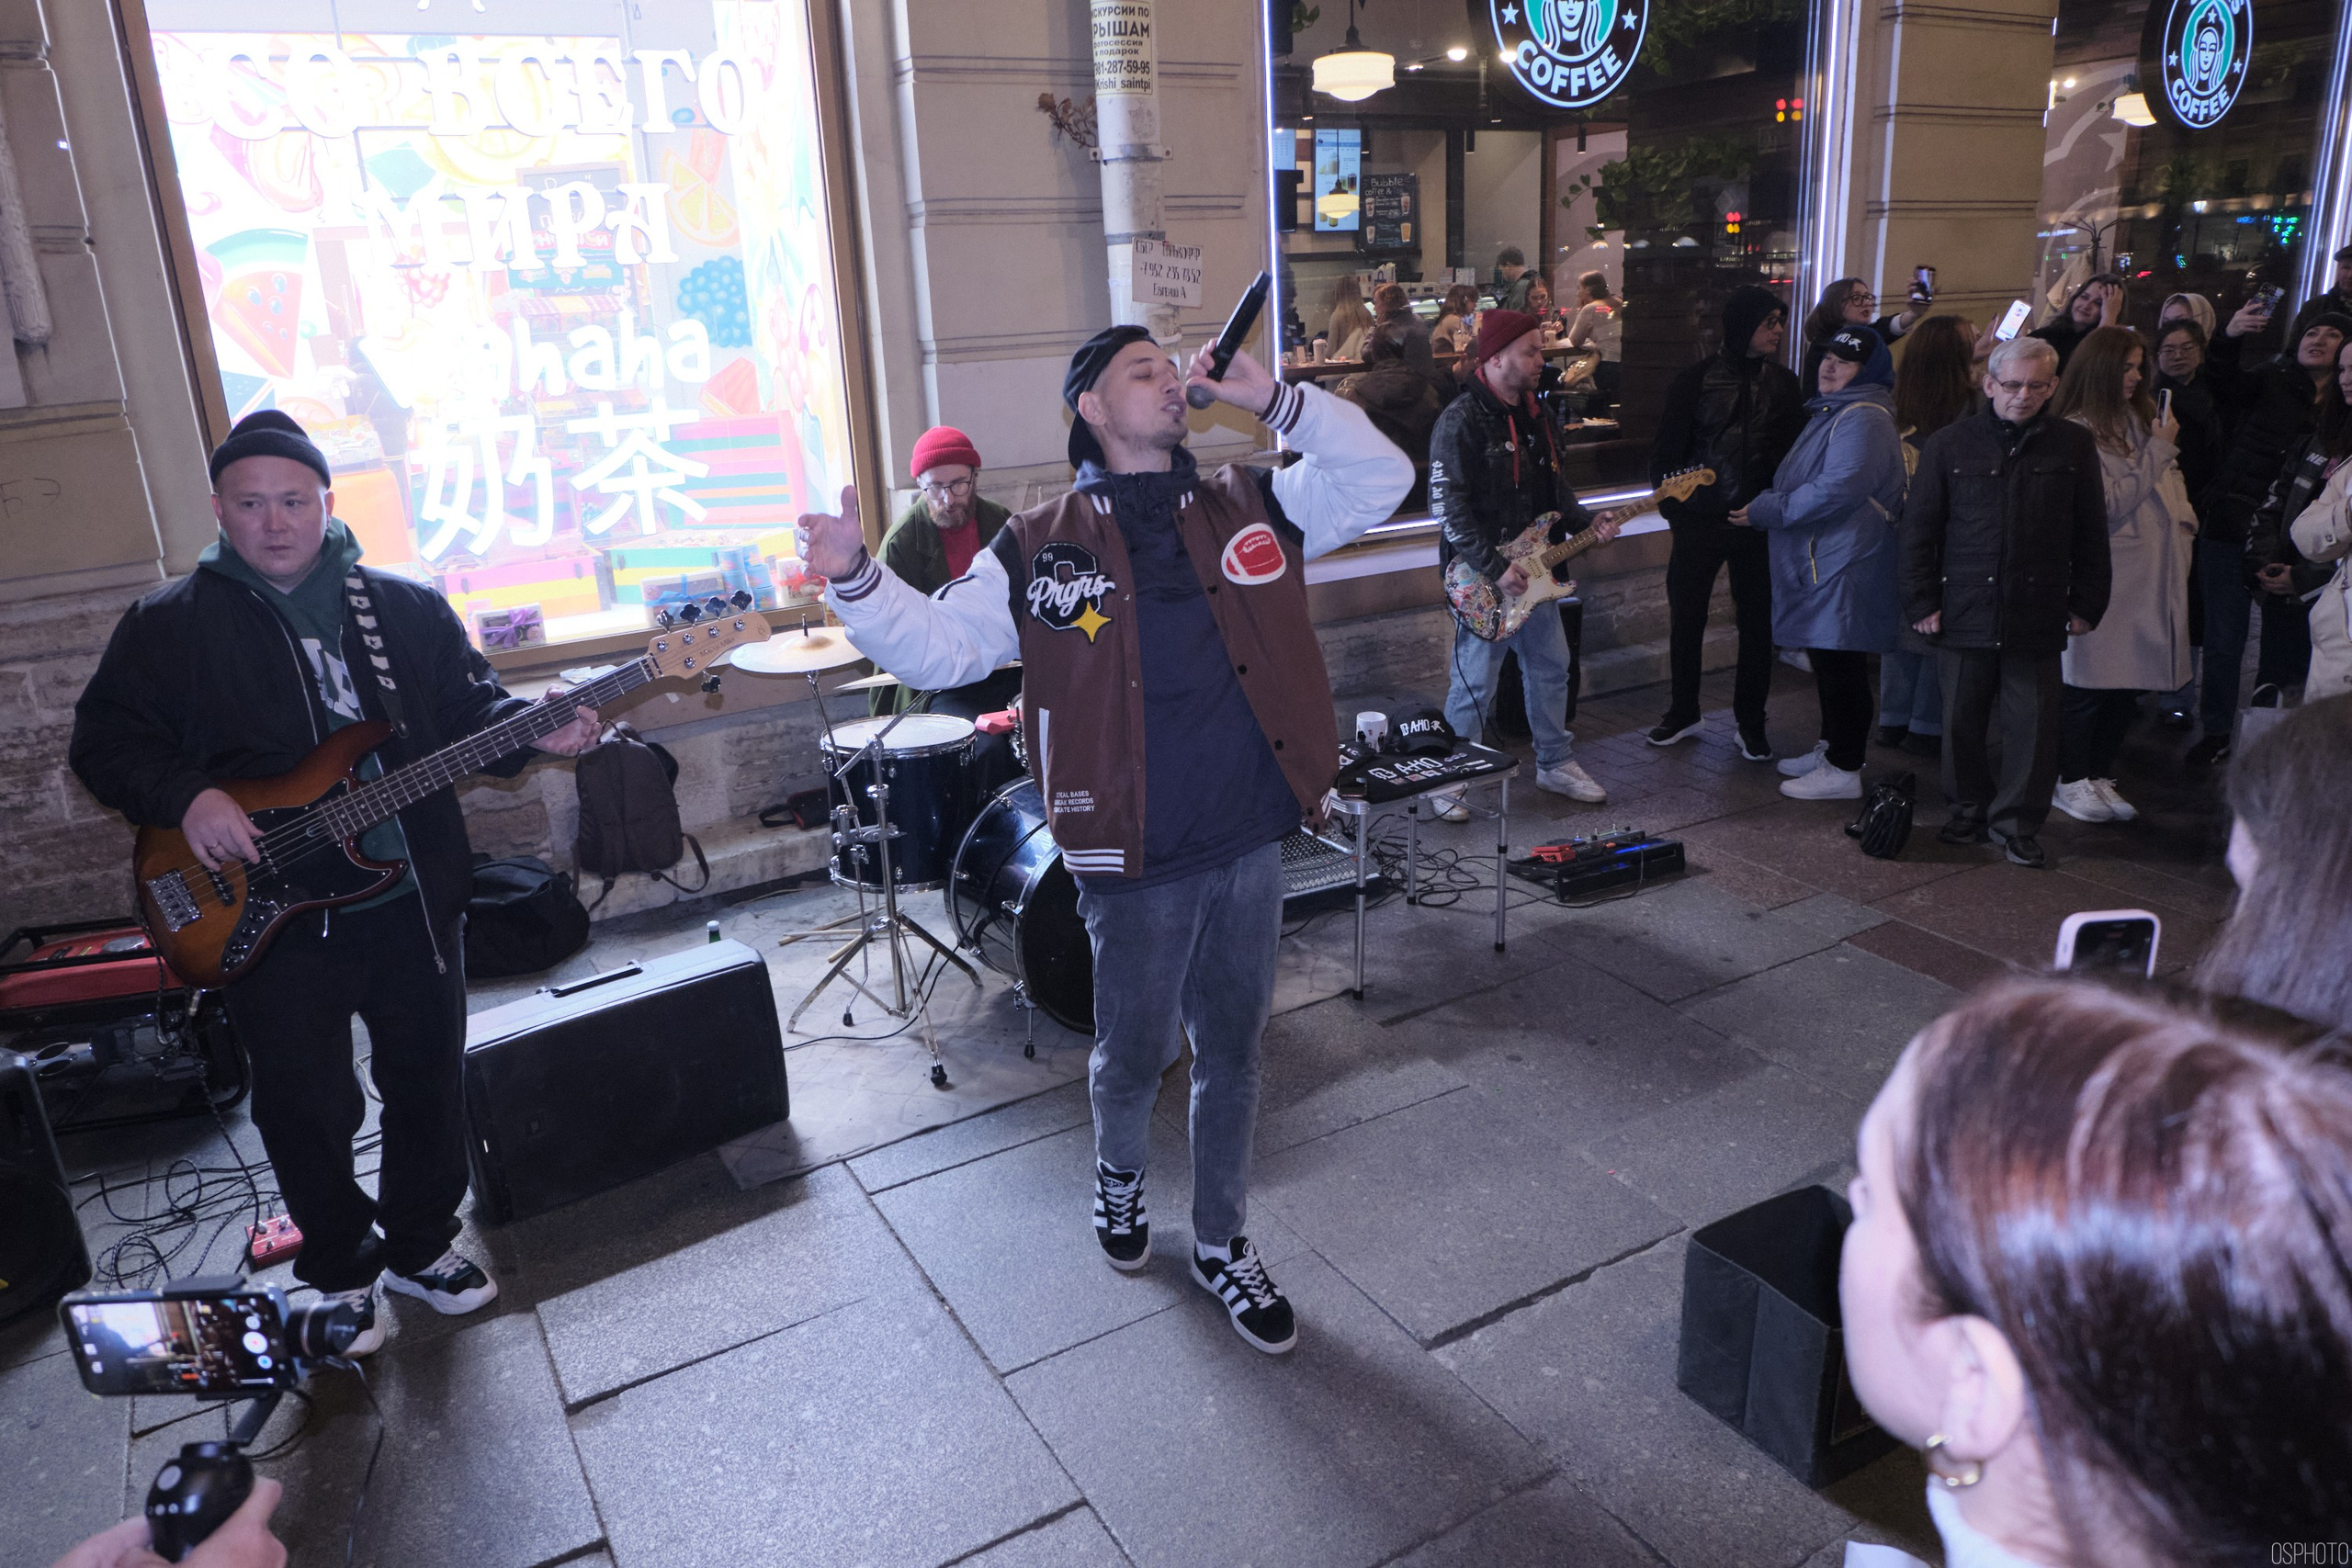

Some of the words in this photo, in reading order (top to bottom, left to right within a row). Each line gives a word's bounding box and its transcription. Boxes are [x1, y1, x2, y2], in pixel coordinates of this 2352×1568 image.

[1137, 6, 1149, 17] ПО
[1099, 48, 1139, 56] подарок
[1516, 39, 1623, 97] COFFEE
[416, 45, 746, 138] ВСЕГО
[2171, 77, 2230, 122] COFFEE
[1371, 176, 1403, 187] Bubble
[355, 181, 680, 275] МИРА
[1149, 263, 1163, 277] 952
[1166, 265, 1180, 280] 235
[418, 400, 711, 562] 奶茶
[1042, 552, 1054, 563] 99
[1026, 574, 1116, 618] Prgrs
[1068, 797, 1094, 806] RECORDS
[1070, 805, 1095, 813] HISTORY
